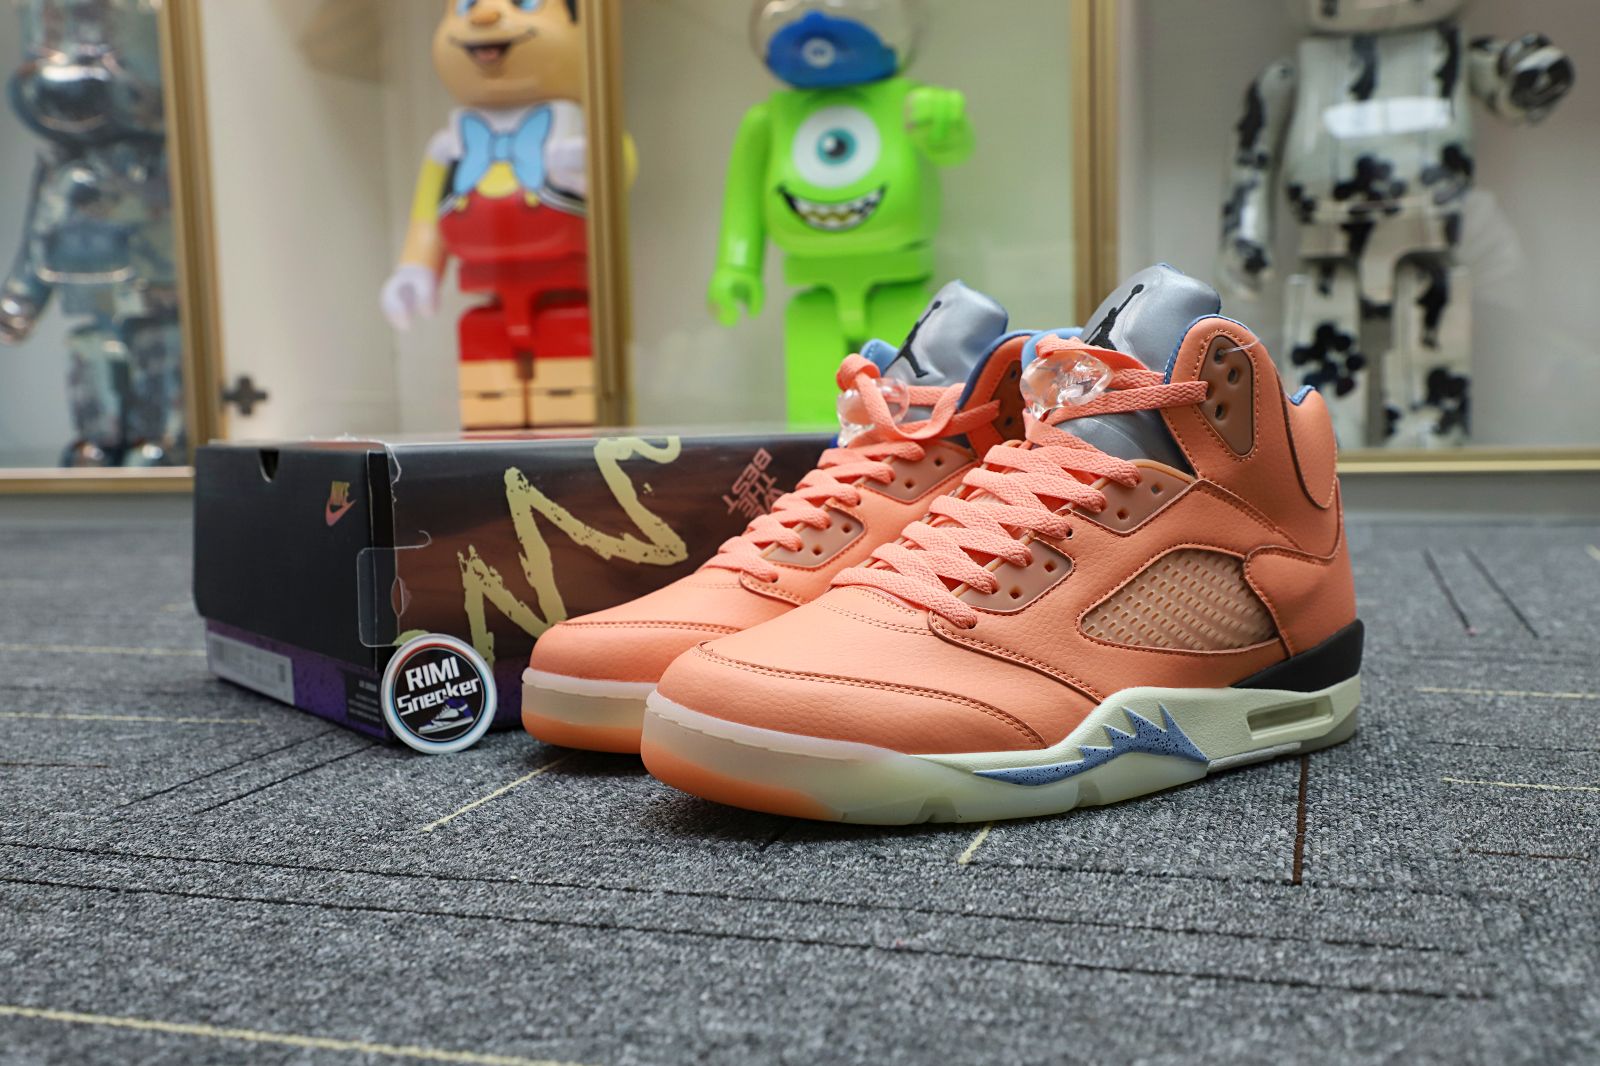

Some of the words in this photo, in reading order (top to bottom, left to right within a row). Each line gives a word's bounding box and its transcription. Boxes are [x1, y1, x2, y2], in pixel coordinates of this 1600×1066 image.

[721, 447, 773, 516] BEST
[738, 471, 778, 518] THE
[404, 656, 461, 692] RIMI
